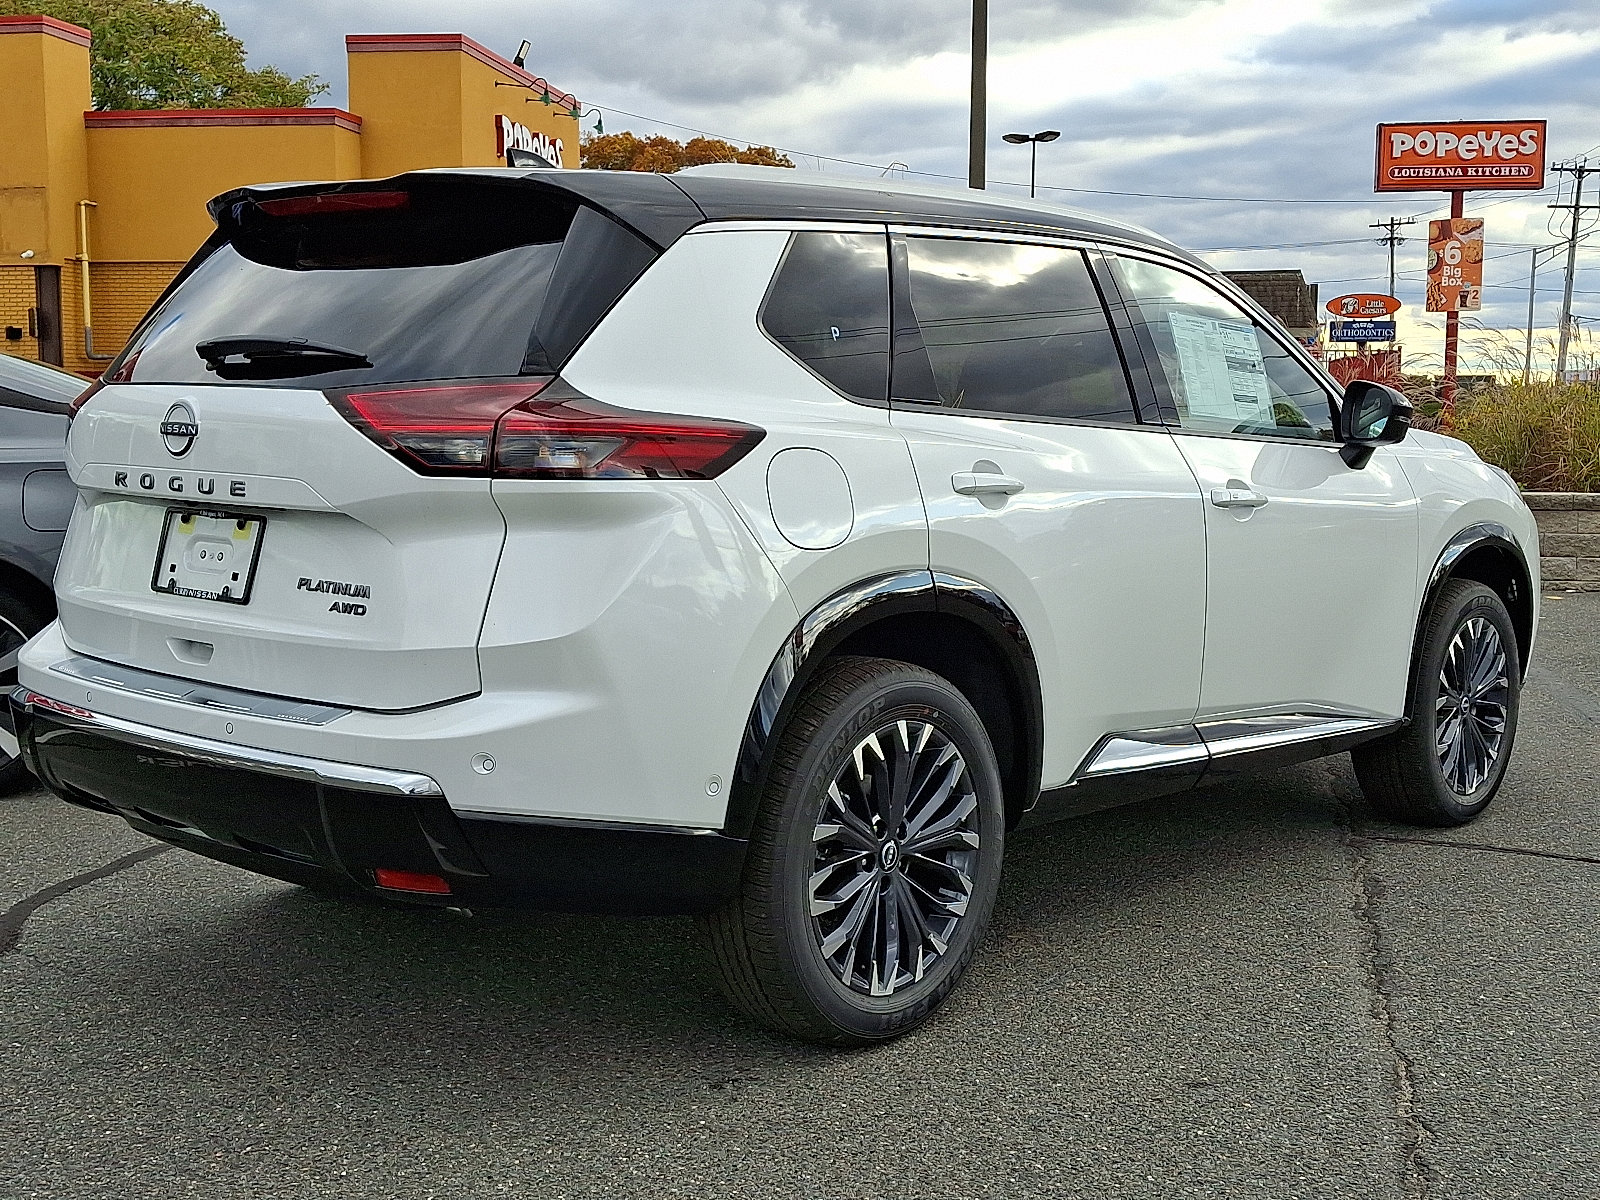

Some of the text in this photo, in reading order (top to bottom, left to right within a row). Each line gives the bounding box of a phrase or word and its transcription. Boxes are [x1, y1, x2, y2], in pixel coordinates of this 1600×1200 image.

[1393, 166, 1530, 177] LOUISIANA KITCHEN
[1439, 240, 1462, 265] $6
[1443, 265, 1462, 278] Big
[1441, 276, 1463, 287] Box
[1366, 299, 1385, 308] Little
[1360, 306, 1387, 315] Caesars
[1332, 328, 1395, 337] ORTHODONTICS
[160, 423, 197, 435] NISSAN
[114, 470, 247, 498] ROGUE
[297, 577, 371, 600] PLATINUM
[188, 589, 218, 600] NISSAN
[328, 601, 368, 616] AWD
